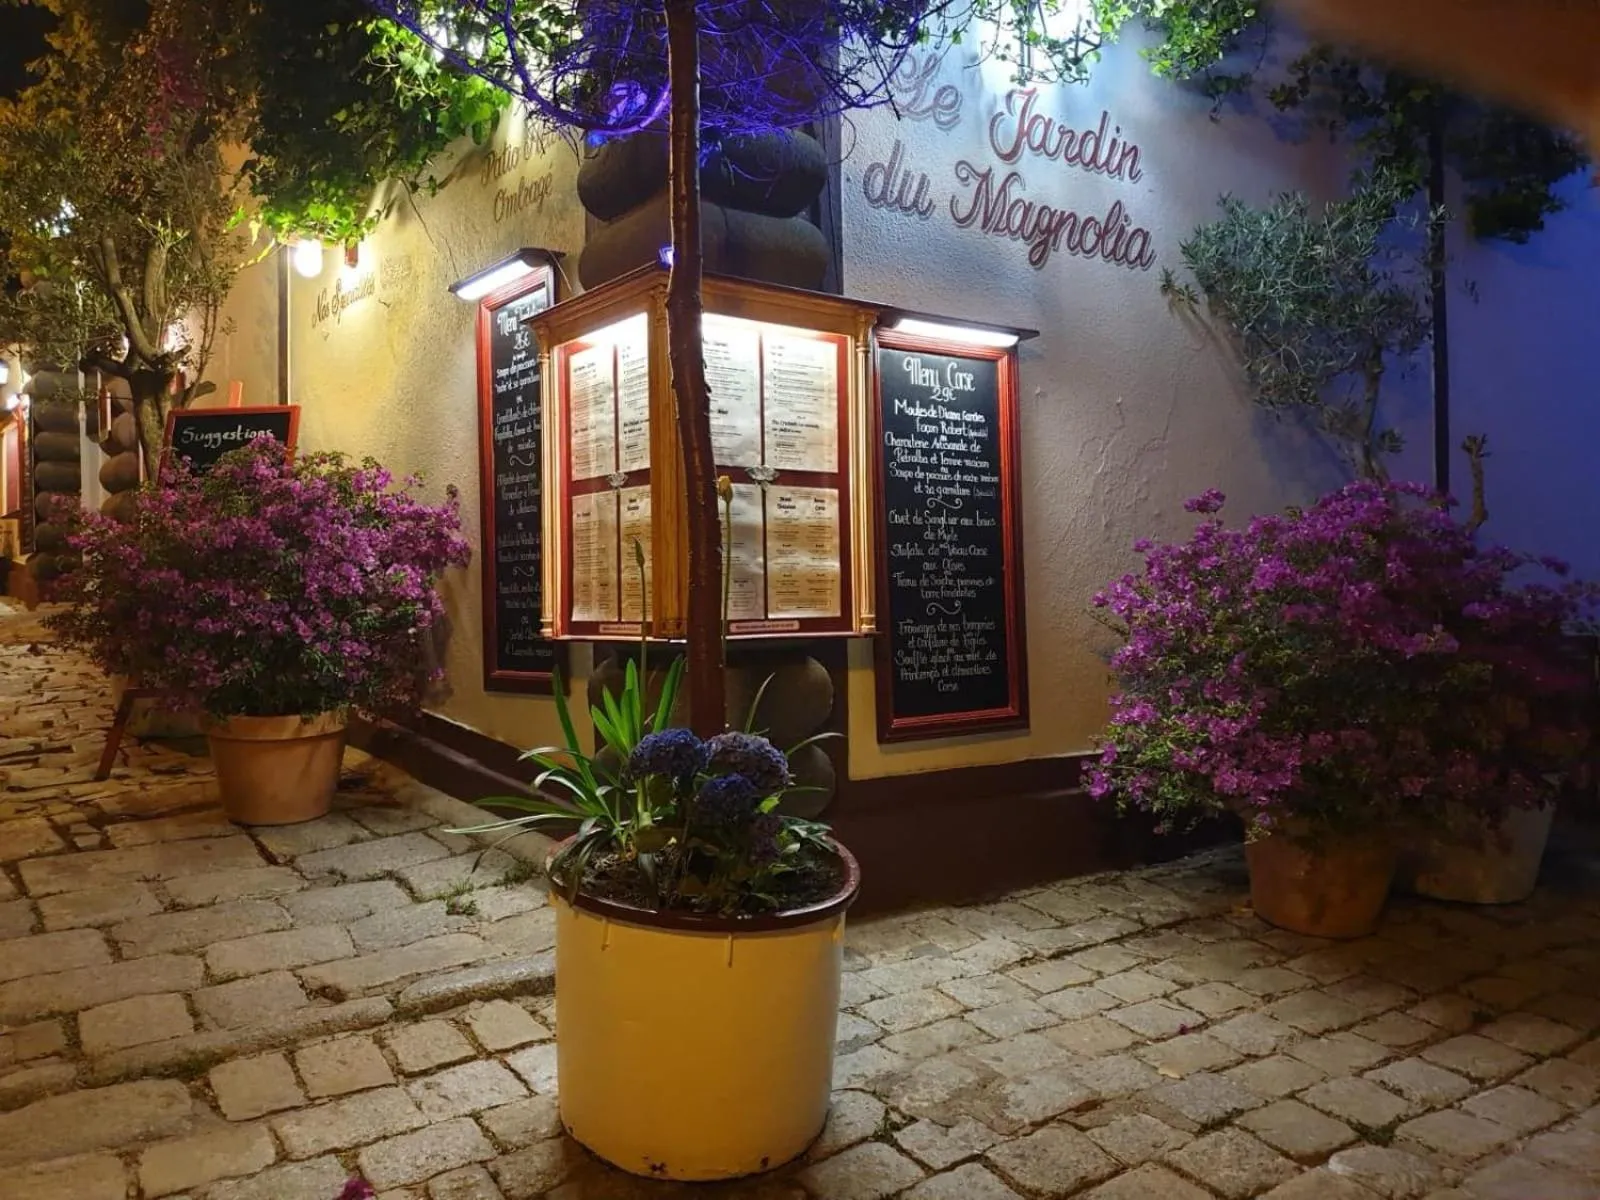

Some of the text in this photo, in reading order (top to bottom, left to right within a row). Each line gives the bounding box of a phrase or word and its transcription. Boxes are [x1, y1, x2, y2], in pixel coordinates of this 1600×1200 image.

[892, 52, 1143, 184] Le Jardin
[481, 141, 520, 187] Patio
[863, 138, 1157, 270] du Magnolia
[902, 356, 976, 392] Menu Corse
[930, 386, 957, 402] 29€
[894, 398, 926, 417] Moules
[927, 404, 937, 418] de
[180, 424, 275, 449] Suggestions
[970, 439, 981, 453] de
[930, 452, 938, 464] et
[889, 461, 913, 482] Soupe
[914, 465, 924, 479] de
[953, 469, 963, 481] de
[914, 483, 923, 494] et
[924, 484, 935, 495] sa
[912, 508, 923, 525] de
[923, 526, 936, 540] de
[928, 543, 939, 556] de
